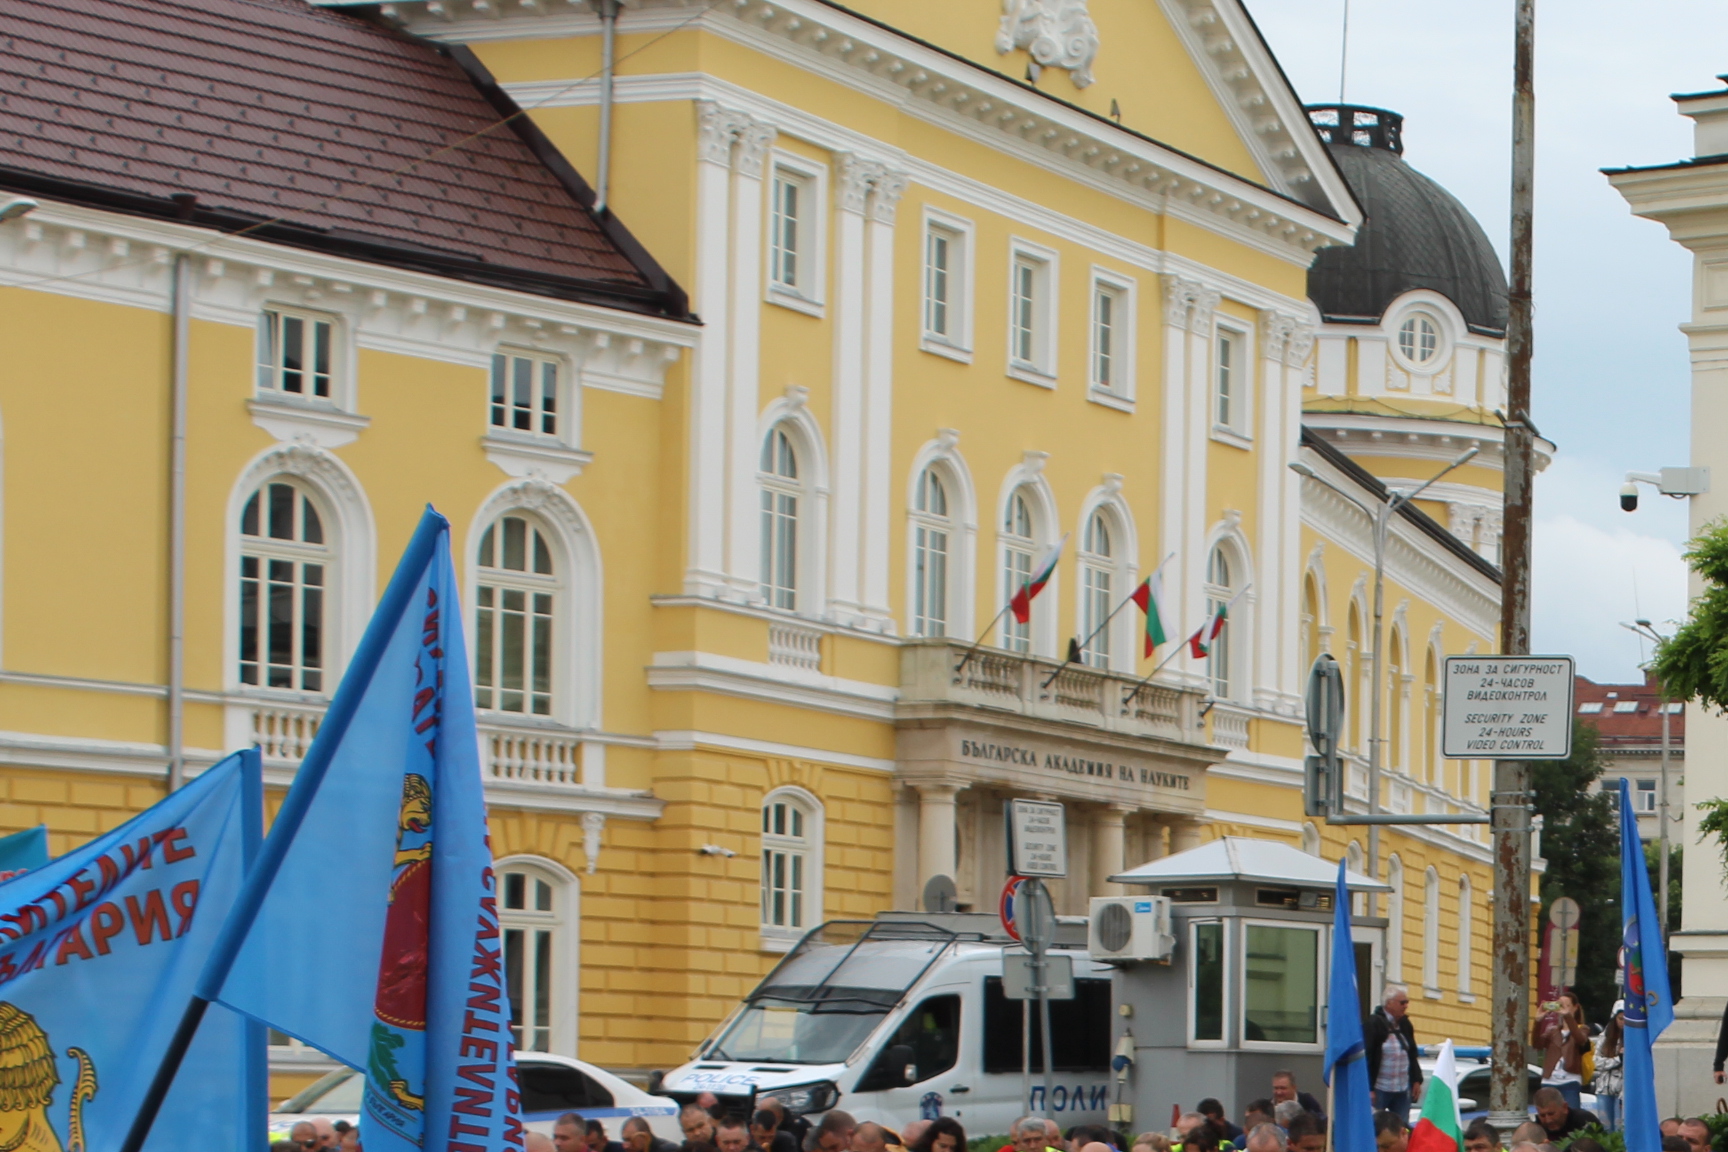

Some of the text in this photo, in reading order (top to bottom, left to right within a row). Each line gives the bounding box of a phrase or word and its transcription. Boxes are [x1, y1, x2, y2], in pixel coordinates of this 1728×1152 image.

[1453, 664, 1563, 674] ЗОНА ЗА СИГУРНОСТ
[1480, 678, 1534, 688] 24-ЧАСОВ
[1467, 691, 1547, 701] ВИДЕОКОНТРОЛ
[1465, 713, 1548, 724] SECURITY ZONE
[1479, 727, 1533, 737] 24-HOURS
[1466, 740, 1544, 750] VIDEO CONTROL
[962, 740, 1190, 790] БЪЛГАРСКА АКАДЕМИЯ НА НАУКИТЕ
[680, 1073, 761, 1086] POLICE
[1029, 1085, 1107, 1112] ПОЛИ
